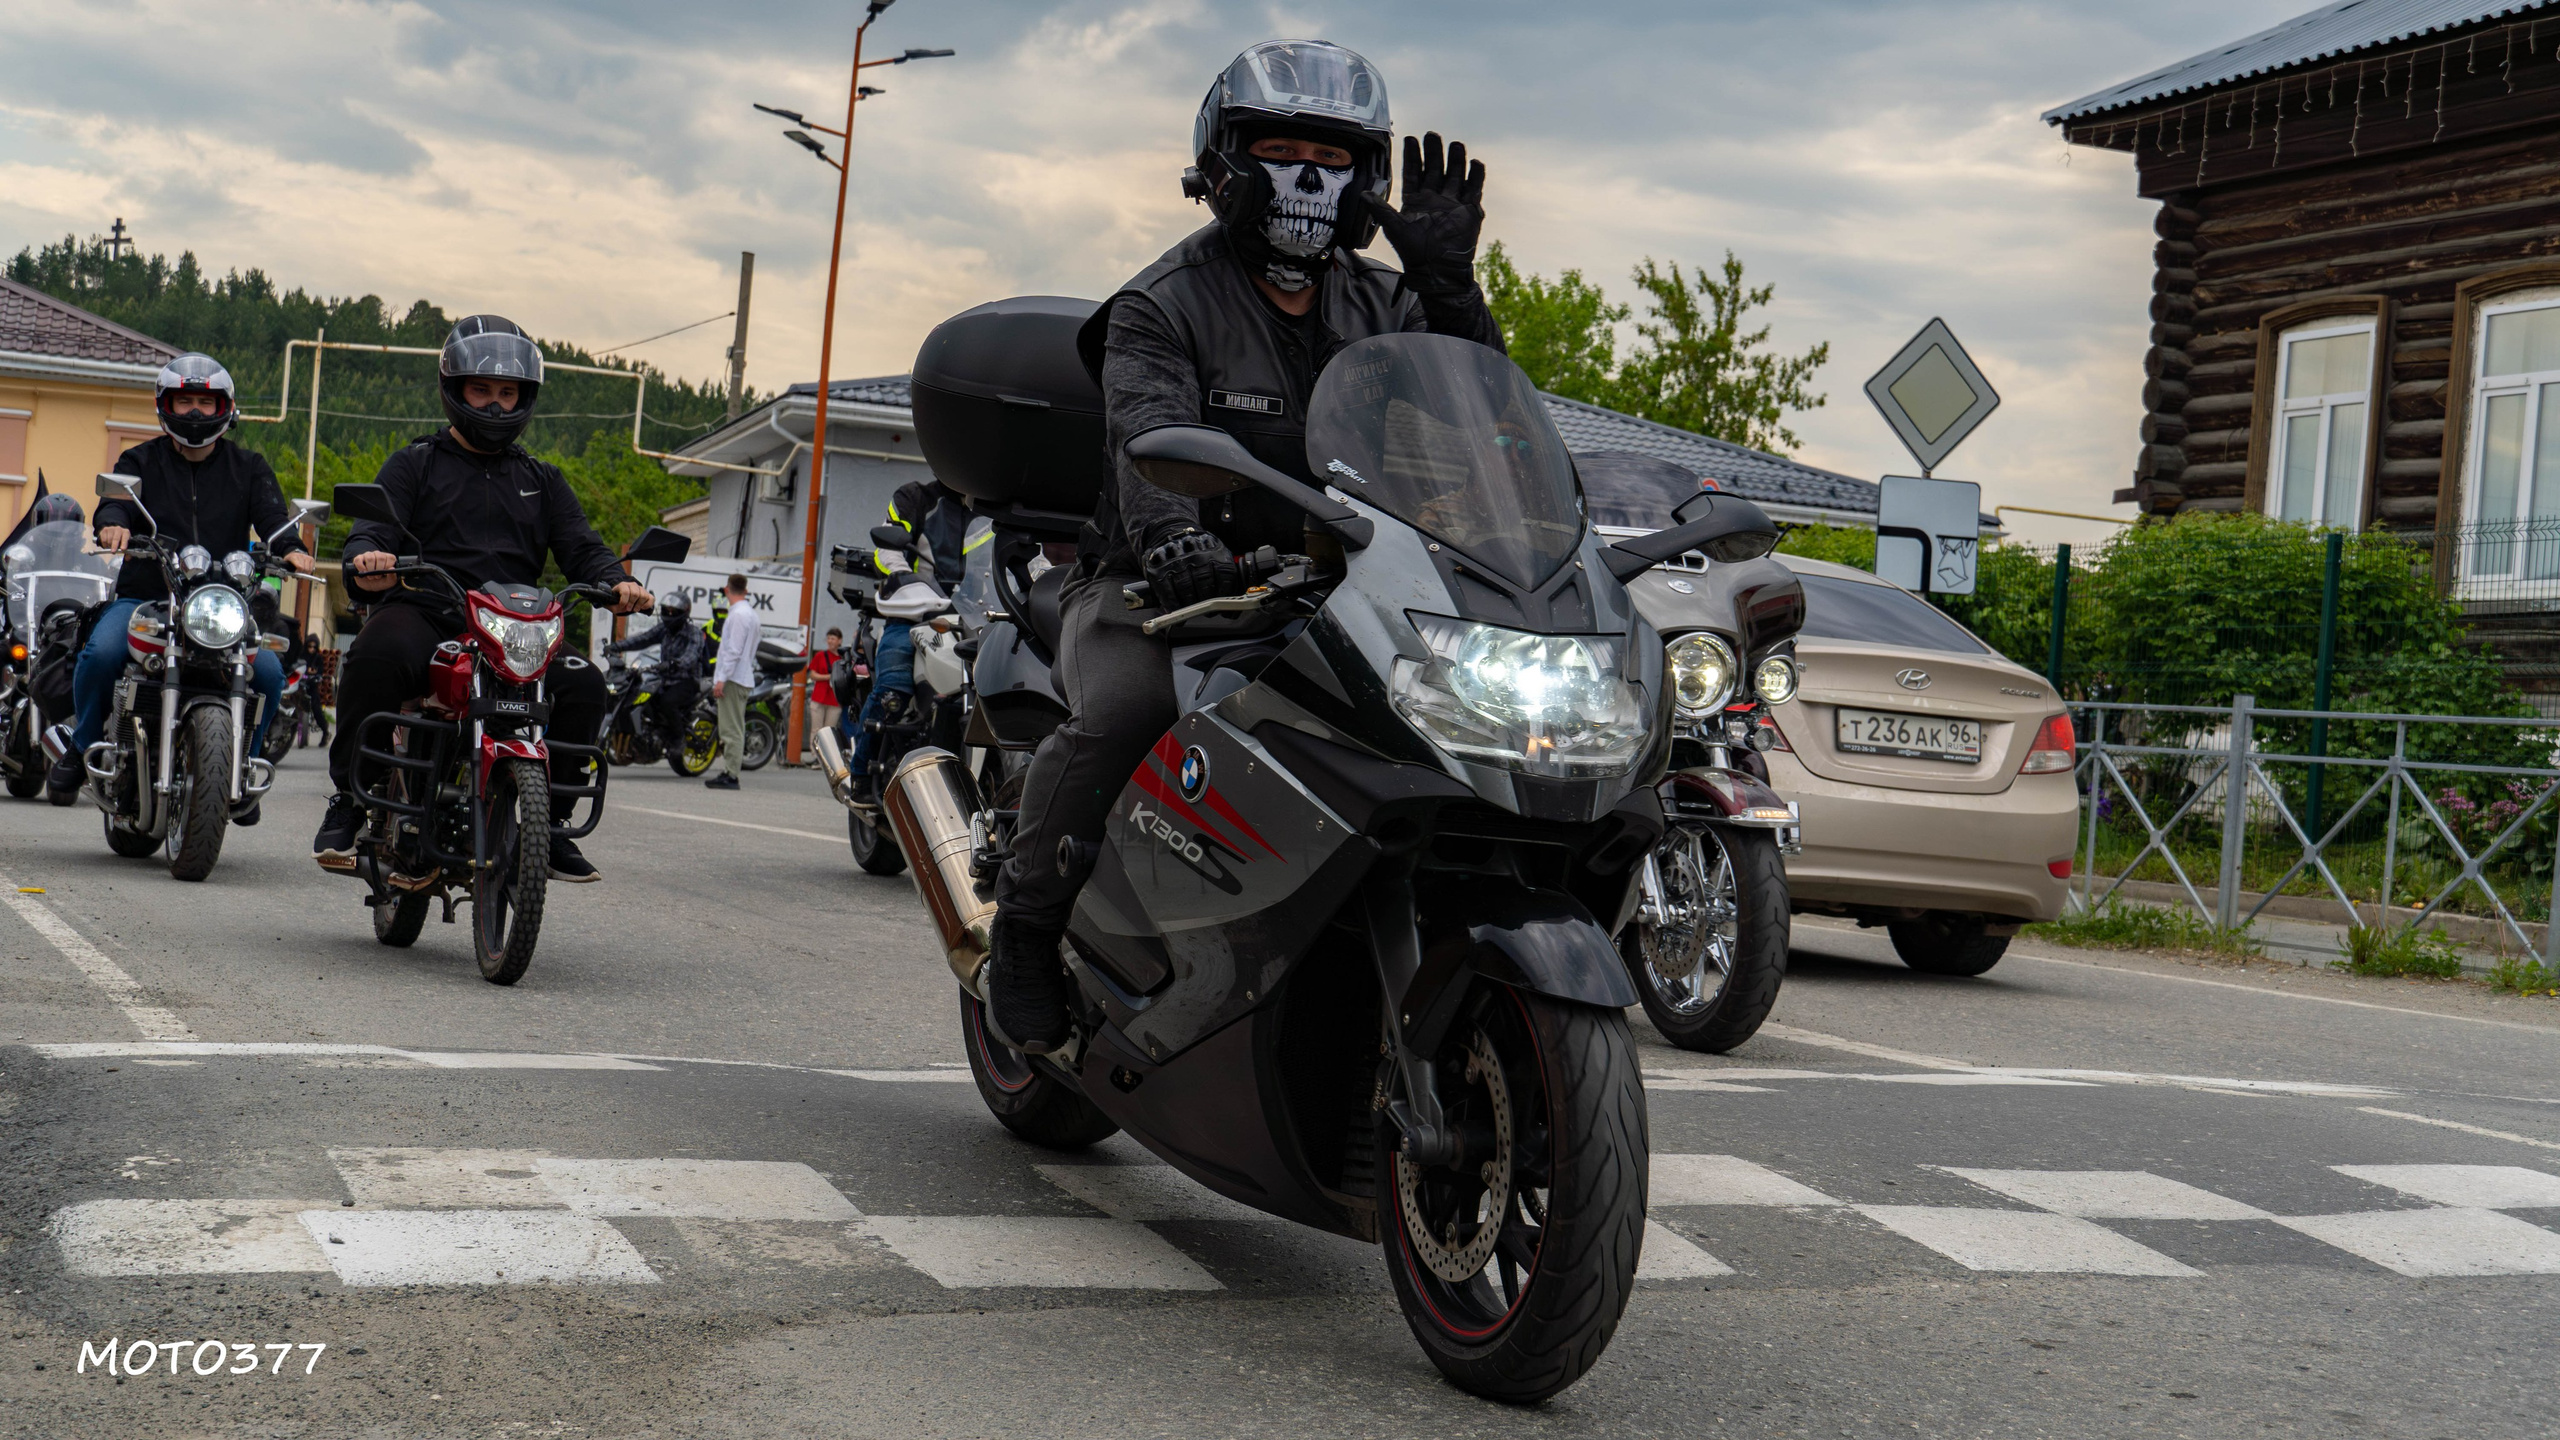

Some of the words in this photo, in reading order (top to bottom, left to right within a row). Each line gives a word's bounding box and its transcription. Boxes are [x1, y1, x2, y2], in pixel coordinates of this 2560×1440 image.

[1288, 96, 1356, 114] LS2
[1226, 394, 1268, 411] МИШАНЯ
[501, 703, 525, 711] VMC
[1949, 723, 1971, 743] 96
[1948, 742, 1965, 750] RUS
